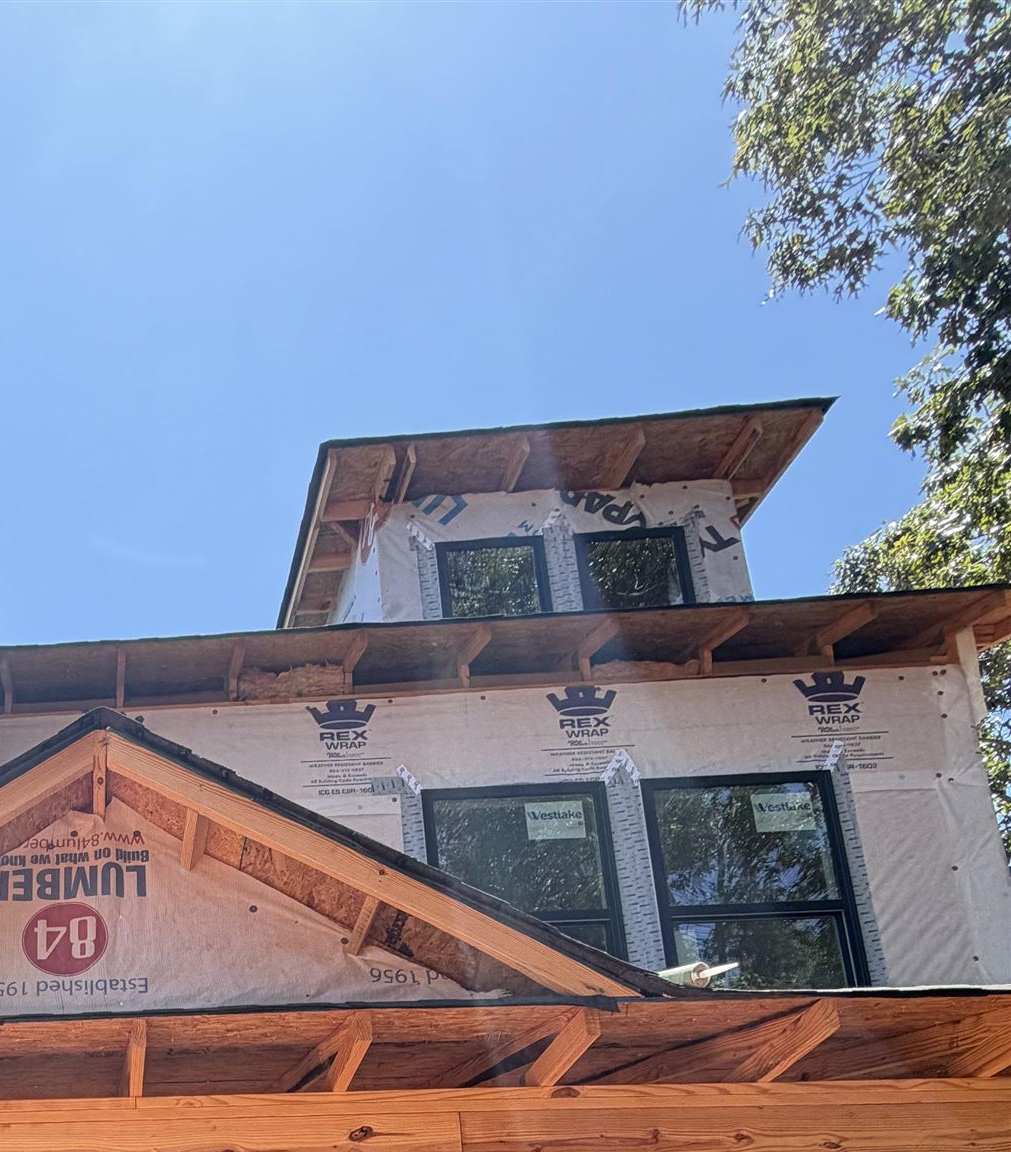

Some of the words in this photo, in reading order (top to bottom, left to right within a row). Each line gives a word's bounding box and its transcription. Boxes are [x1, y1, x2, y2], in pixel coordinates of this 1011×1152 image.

[808, 703, 861, 715] REX
[559, 717, 610, 729] REX
[815, 715, 860, 724] WRAP
[320, 730, 369, 741] REX
[566, 729, 609, 738] WRAP
[325, 741, 366, 750] WRAP
[756, 802, 811, 812] Westlake
[527, 808, 582, 822] Westlake
[31, 854, 50, 865] we
[56, 853, 89, 865] what
[95, 848, 111, 859] on
[116, 848, 149, 862] Build
[35, 916, 96, 960] 84
[370, 968, 420, 984] 1956
[37, 977, 148, 993] Established
